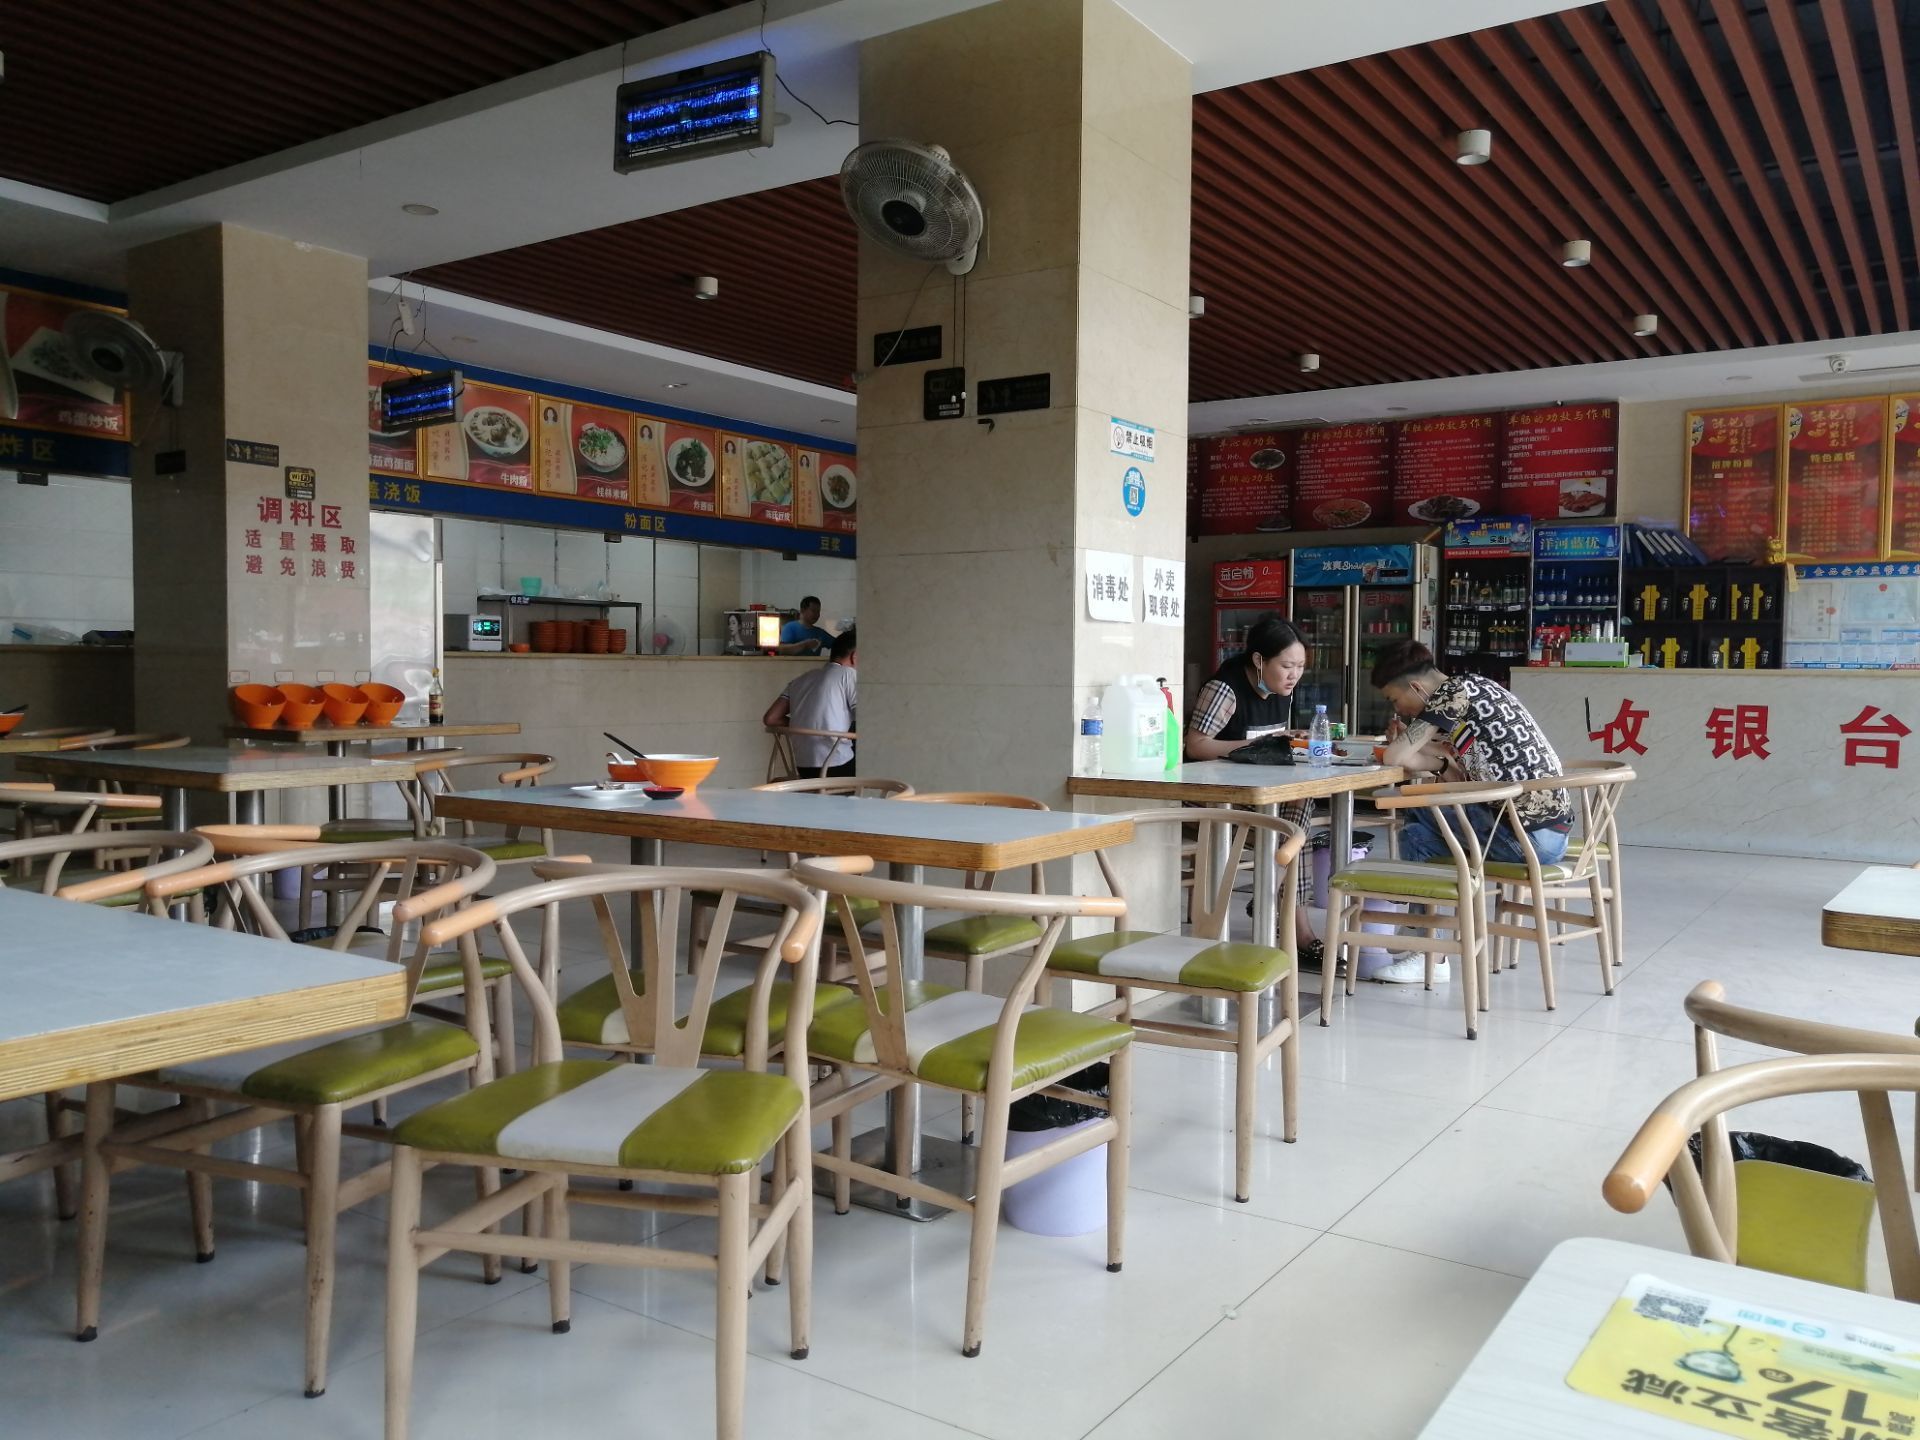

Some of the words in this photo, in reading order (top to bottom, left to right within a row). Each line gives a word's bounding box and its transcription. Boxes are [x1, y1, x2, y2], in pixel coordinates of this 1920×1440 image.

[58, 410, 119, 431] 鸡蛋炒饭
[1126, 430, 1153, 450] 禁止吸烟
[369, 480, 421, 503] 盖浇饭
[500, 472, 529, 487] 牛肉粉
[596, 487, 628, 501] 桂林米粉
[256, 496, 343, 529] 调料区
[623, 512, 666, 533] 粉面区
[245, 529, 356, 555] 适量摄取
[819, 535, 842, 552] 豆浆
[245, 554, 356, 580] 避免浪费
[1092, 573, 1129, 602] 消毒处
[1153, 568, 1175, 593] 外卖
[1148, 593, 1180, 619] 取餐处
[1588, 698, 1912, 769] 收银台
[1766, 1380, 1882, 1429] 17
